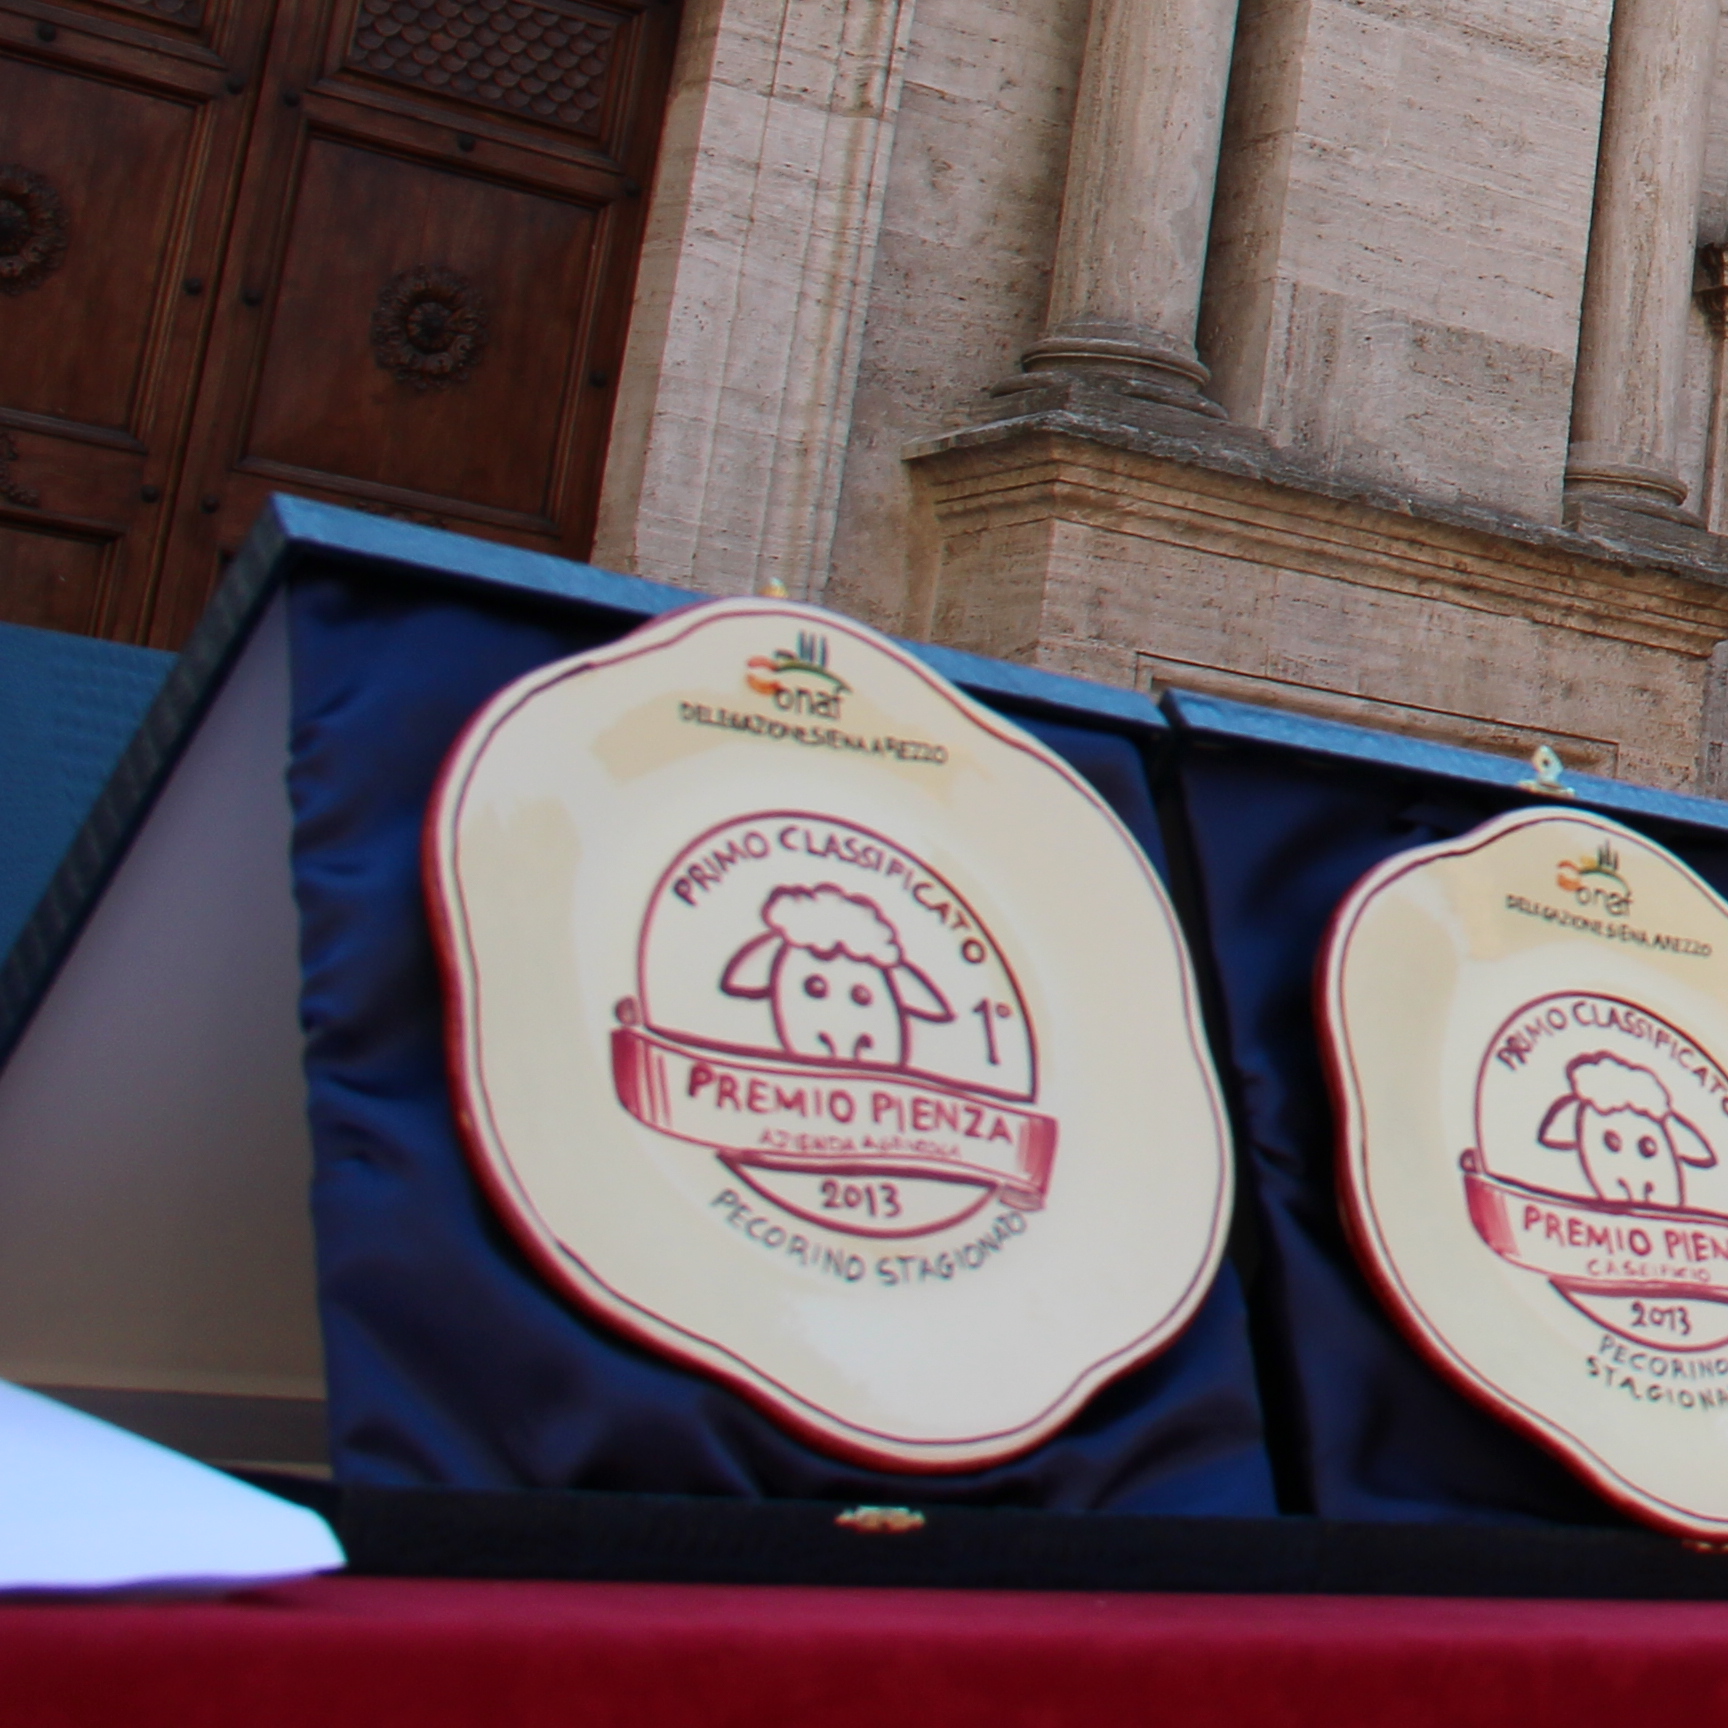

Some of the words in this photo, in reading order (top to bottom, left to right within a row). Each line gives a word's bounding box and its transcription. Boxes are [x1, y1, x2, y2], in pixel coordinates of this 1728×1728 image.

[673, 830, 771, 907] PRIMO
[779, 825, 987, 966] CLASSIFICATO
[1496, 1007, 1568, 1070] PRIMO
[688, 1061, 857, 1124] PREMIO
[872, 1090, 1014, 1145] PIENZA
[819, 1179, 903, 1218] 2013
[1523, 1204, 1652, 1256] PREMIO
[711, 1187, 867, 1283] PECORINO
[1631, 1301, 1692, 1335] 2013
